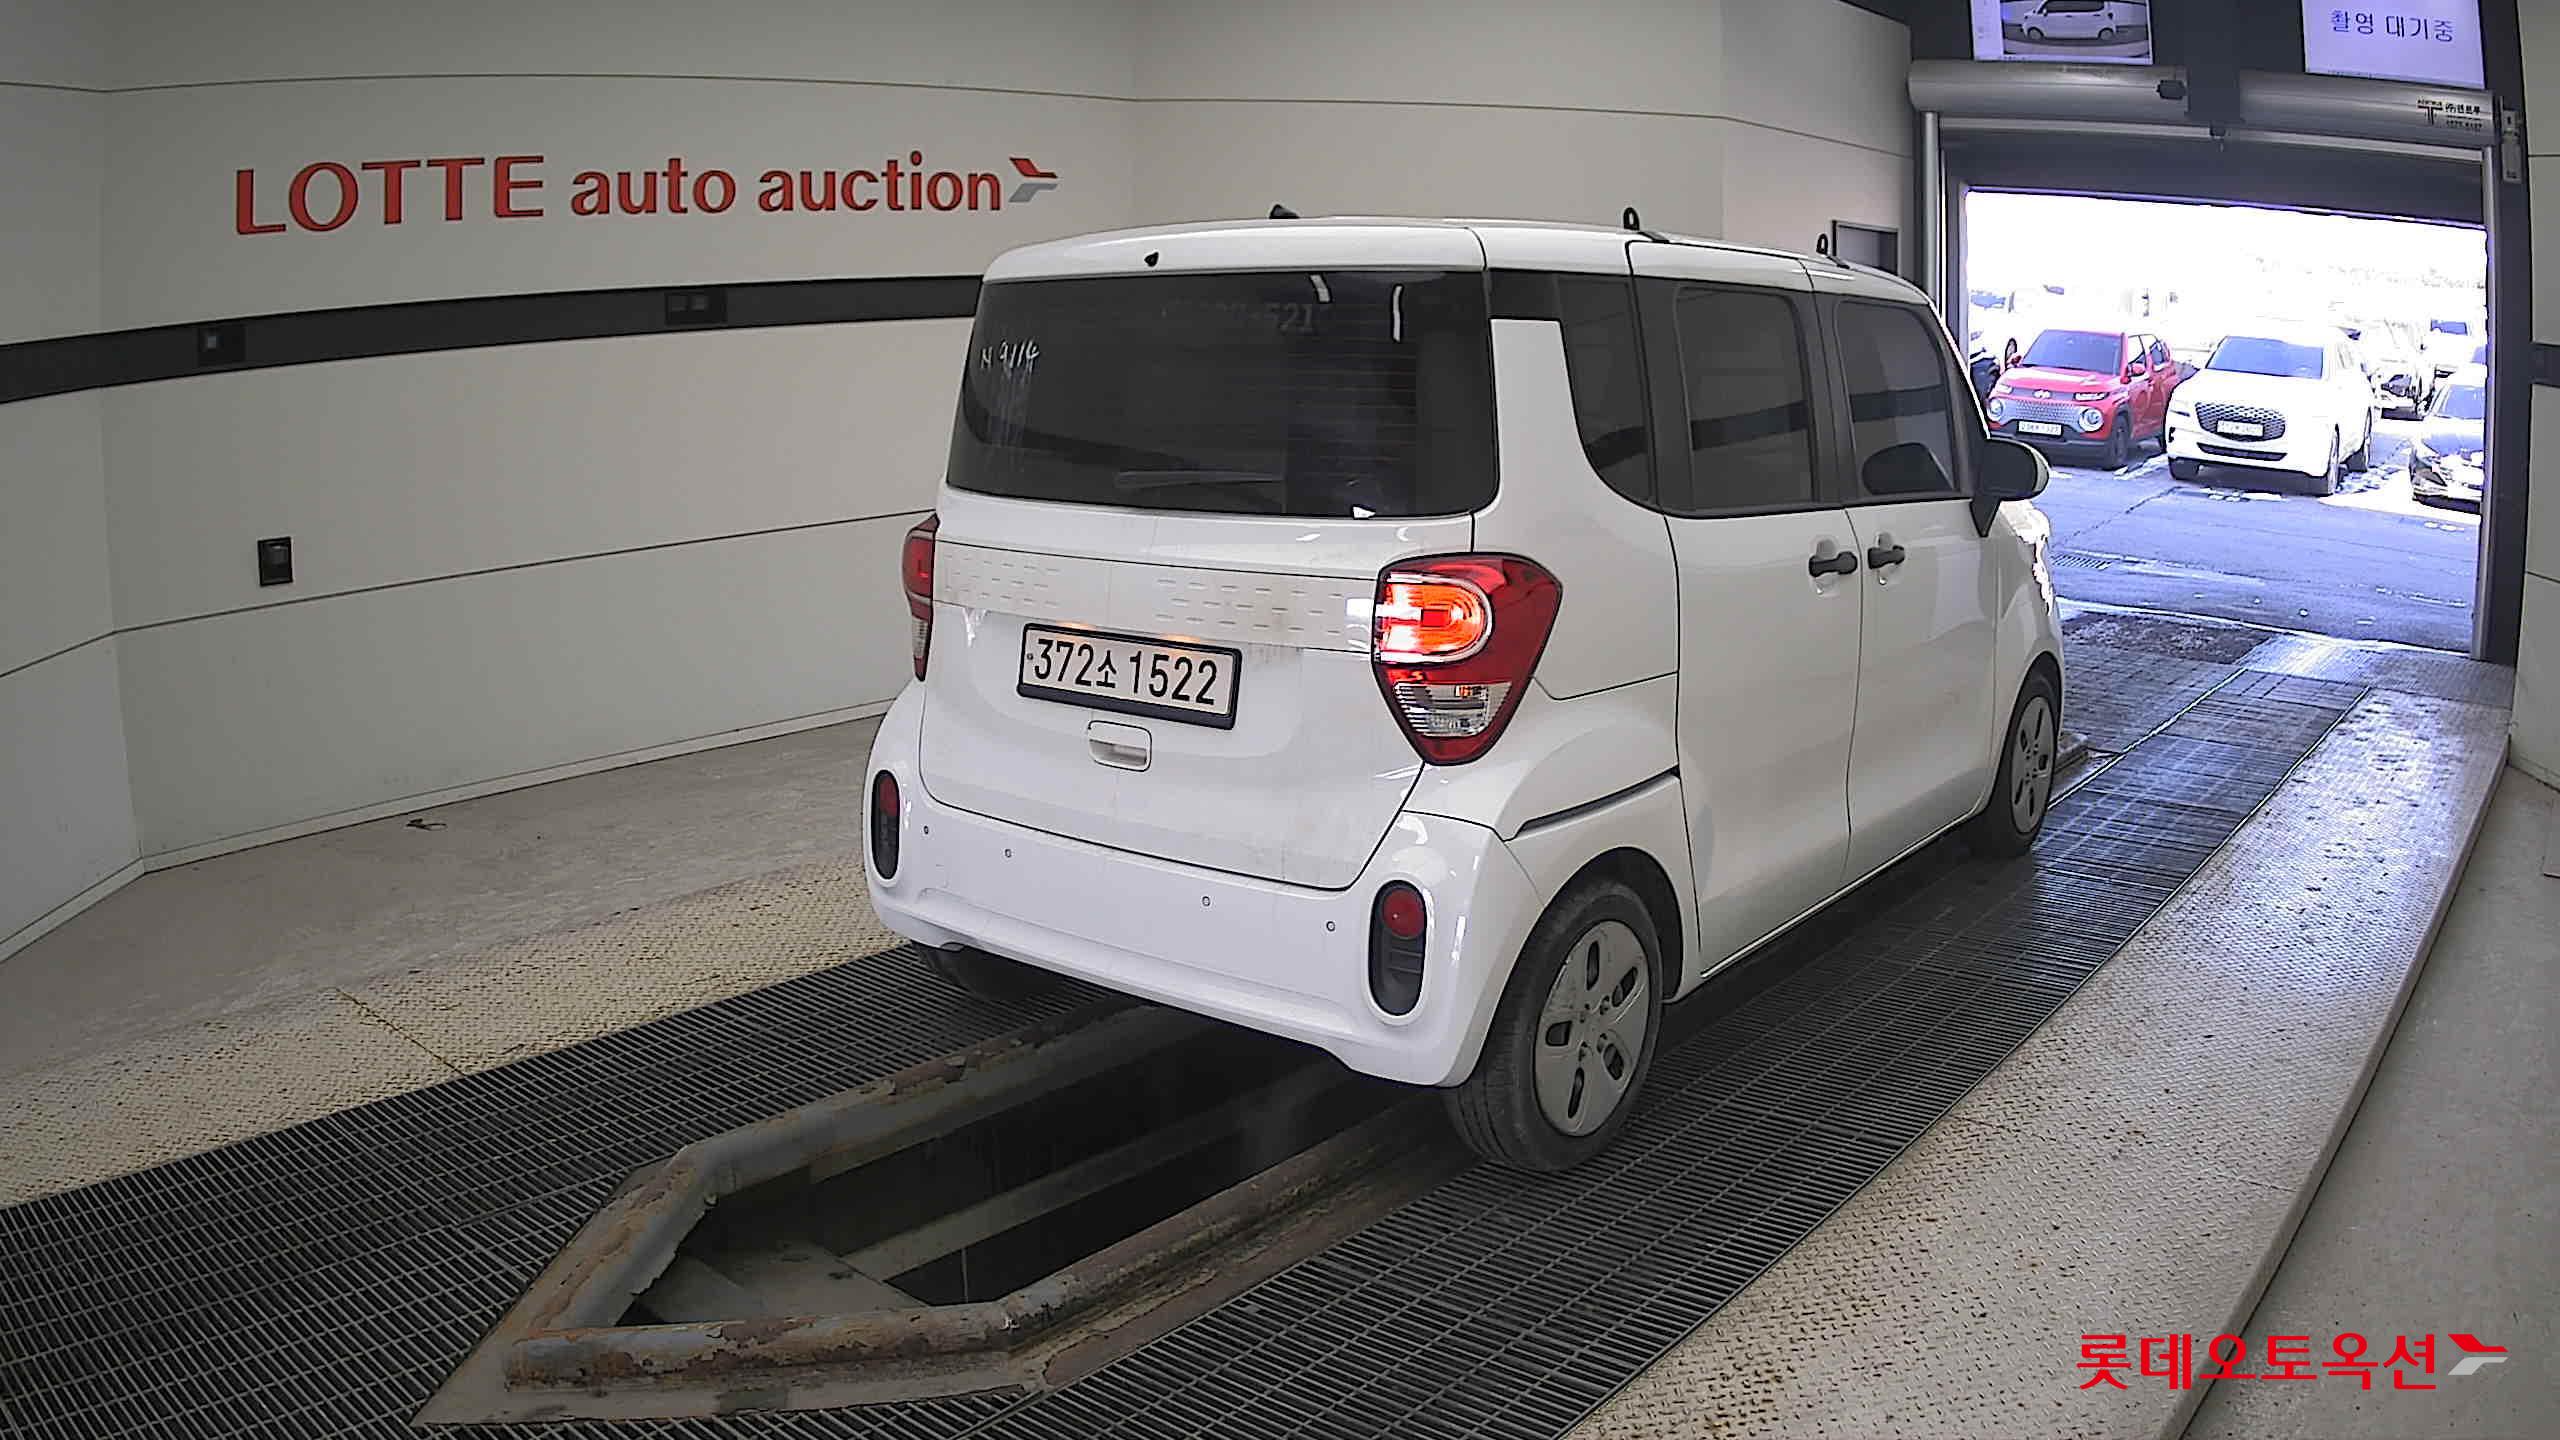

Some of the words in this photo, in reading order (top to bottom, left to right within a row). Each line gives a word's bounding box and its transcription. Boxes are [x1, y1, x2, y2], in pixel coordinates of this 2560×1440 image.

[2330, 9, 2375, 36] 촬영
[2385, 15, 2454, 43] 대기중
[236, 155, 546, 236] LOTTE
[571, 158, 738, 217] auto
[757, 151, 1003, 213] auction
[1033, 637, 1118, 690] 372소
[1129, 650, 1219, 706] 1522
